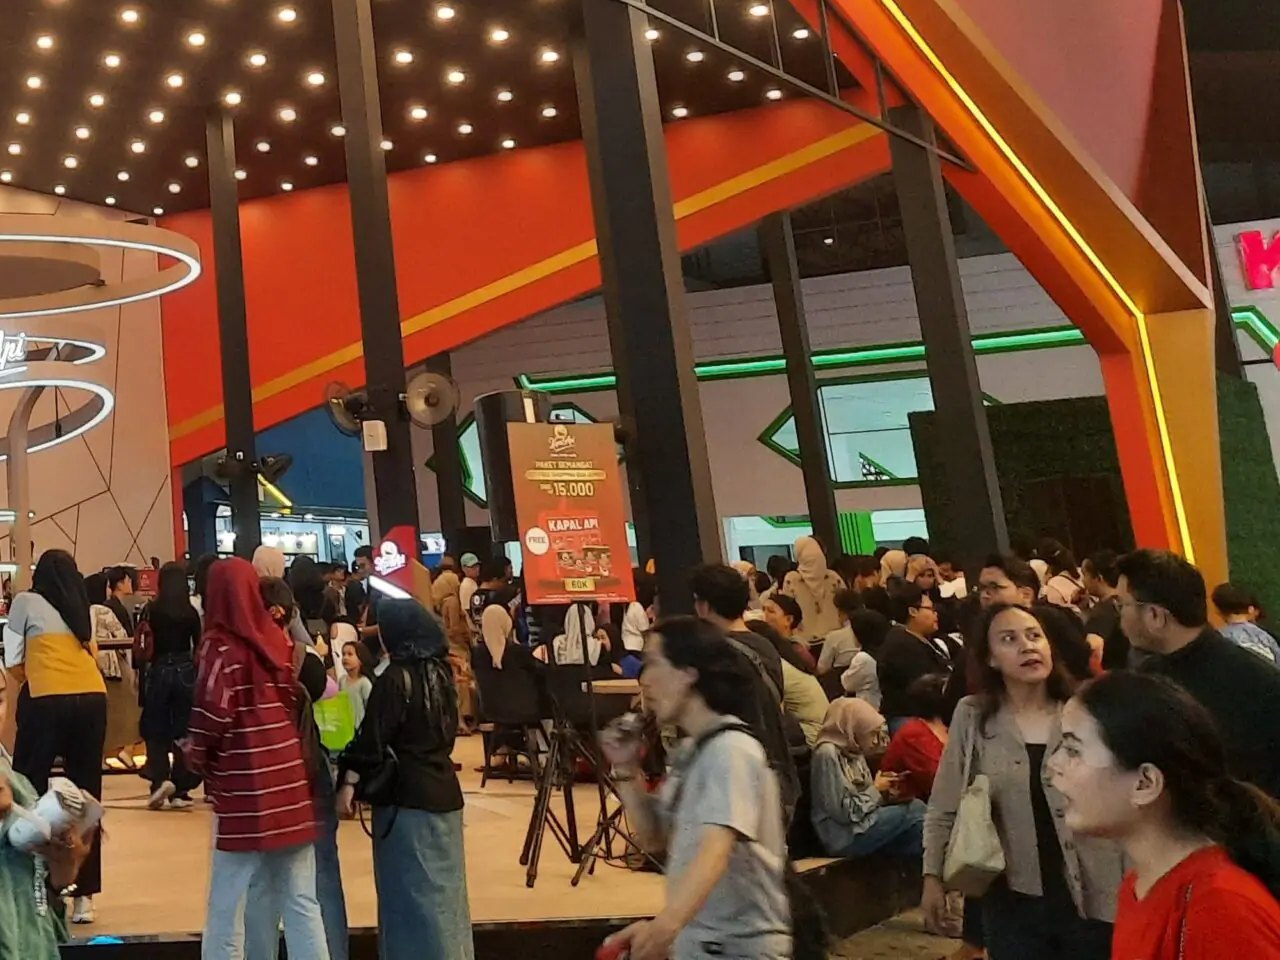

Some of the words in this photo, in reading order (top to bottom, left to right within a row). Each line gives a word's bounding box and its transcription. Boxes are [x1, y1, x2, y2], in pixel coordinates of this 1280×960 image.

[553, 482, 594, 496] 15.000
[548, 519, 582, 531] KAPAL
[583, 519, 599, 528] API
